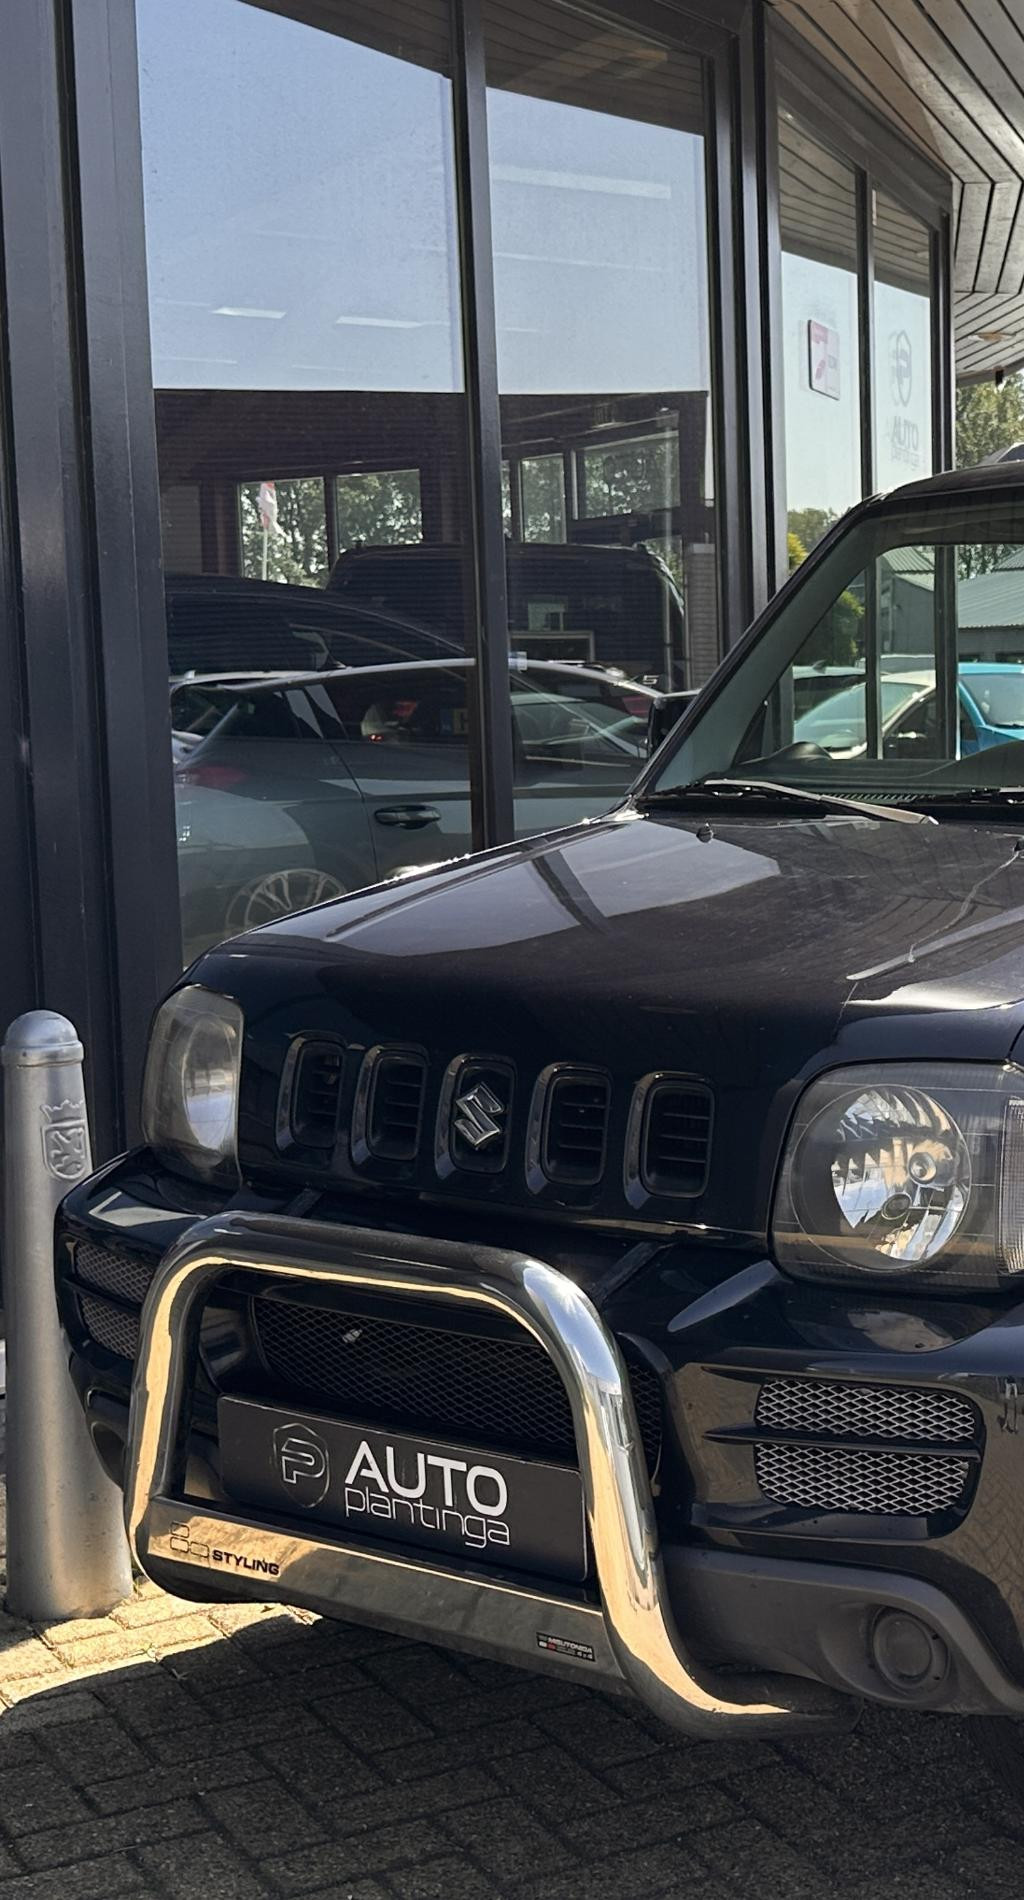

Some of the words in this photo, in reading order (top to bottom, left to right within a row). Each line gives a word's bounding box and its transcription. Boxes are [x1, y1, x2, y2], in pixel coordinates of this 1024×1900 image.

[345, 1440, 508, 1517] AUTO
[345, 1486, 511, 1549] plantinga
[212, 1549, 280, 1576] STYLING
